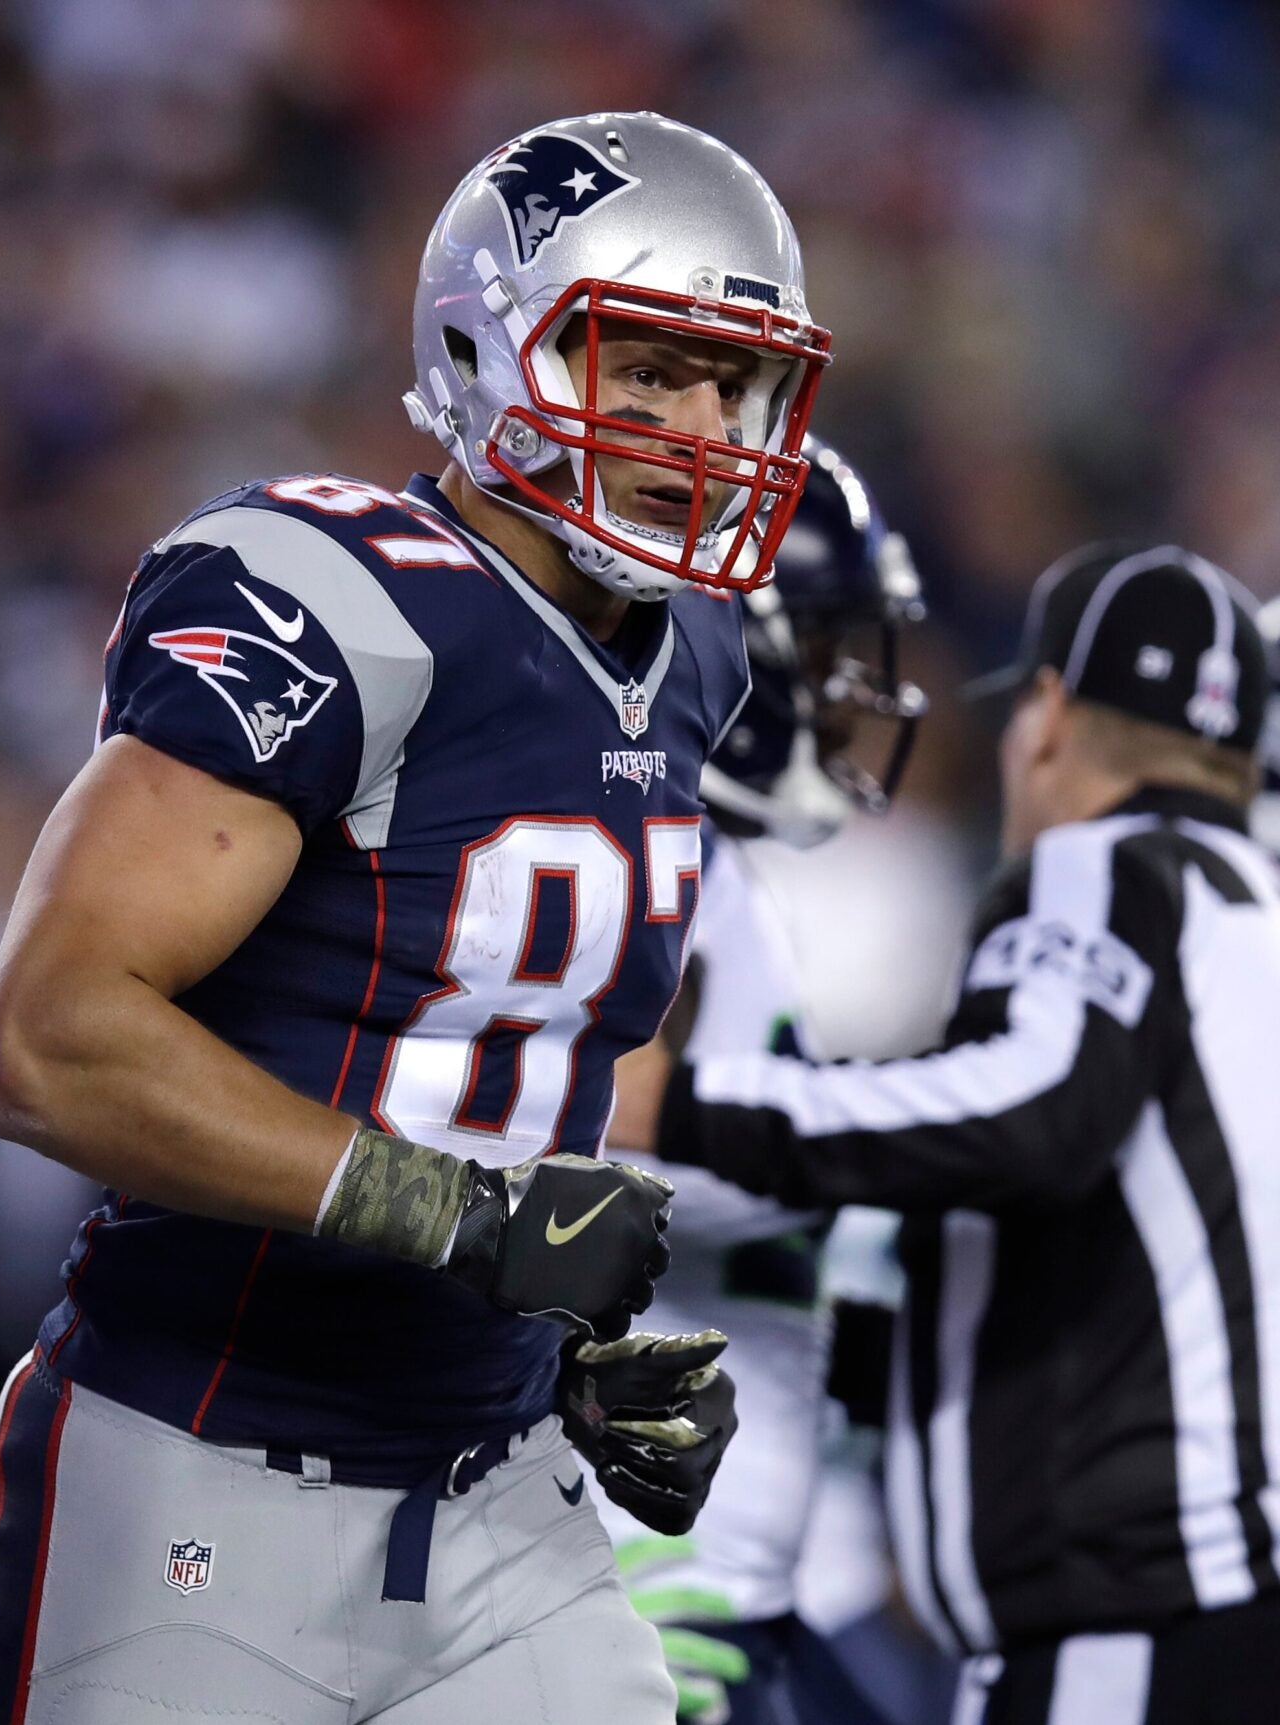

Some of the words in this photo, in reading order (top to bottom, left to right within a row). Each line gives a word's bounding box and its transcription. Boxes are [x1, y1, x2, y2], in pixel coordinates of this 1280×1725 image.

[624, 706, 645, 729] NFL
[601, 751, 667, 783] PATRIOTS
[171, 1561, 204, 1586] NFL
